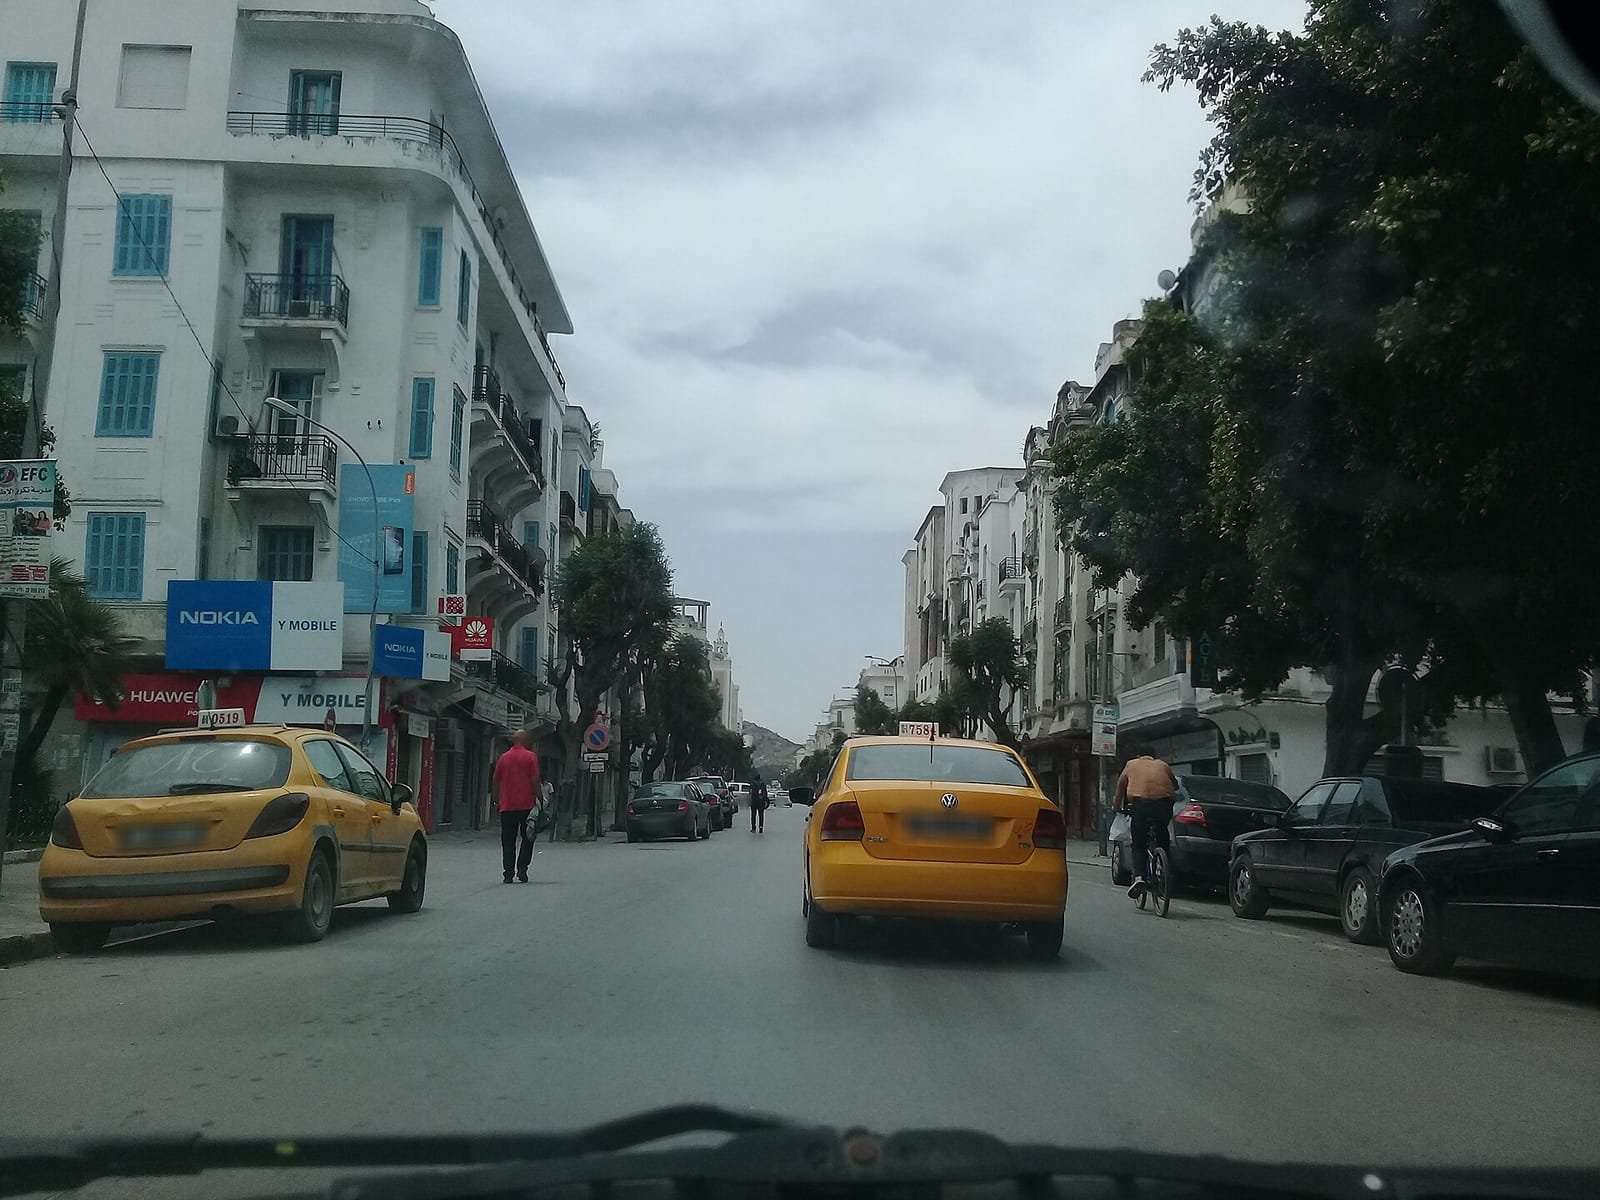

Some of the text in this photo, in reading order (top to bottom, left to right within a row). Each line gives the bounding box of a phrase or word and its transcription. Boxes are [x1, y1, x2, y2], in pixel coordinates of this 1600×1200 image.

[20, 467, 48, 481] EFC
[180, 611, 337, 631] NOKIA Y MOBILE
[384, 643, 416, 654] NOKIA
[130, 690, 199, 704] HUAWEI
[280, 693, 366, 708] Y MOBILE
[211, 712, 239, 725] 0519
